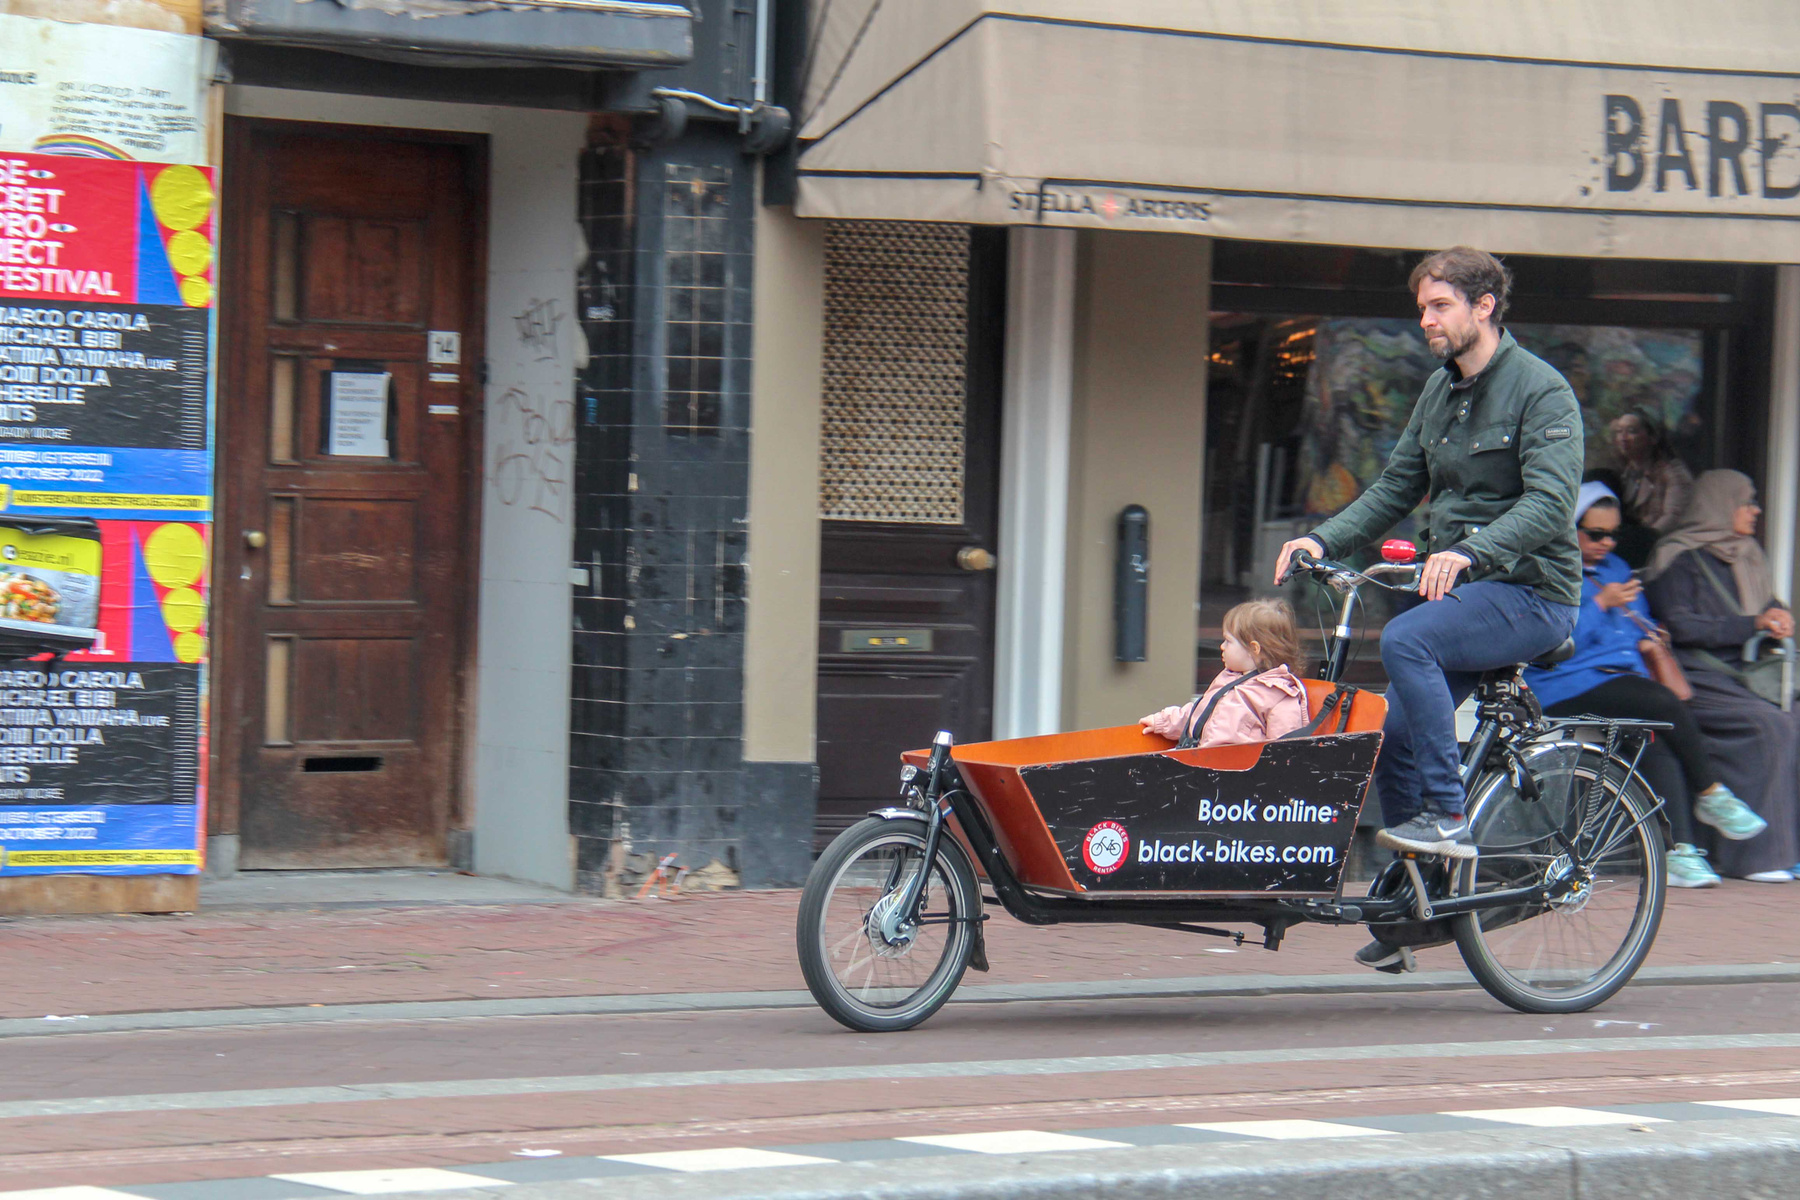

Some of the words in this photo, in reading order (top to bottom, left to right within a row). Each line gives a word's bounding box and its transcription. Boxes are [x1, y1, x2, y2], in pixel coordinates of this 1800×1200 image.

[1009, 190, 1097, 215] STELLA
[1123, 198, 1213, 221] ARTOIS
[0, 266, 121, 296] ESTIVAL
[1197, 799, 1257, 823] Book
[1086, 822, 1108, 842] BLACK
[1110, 822, 1129, 843] BIKES
[1137, 839, 1335, 864] black-bikes.com
[1093, 865, 1118, 874] RENTAL
